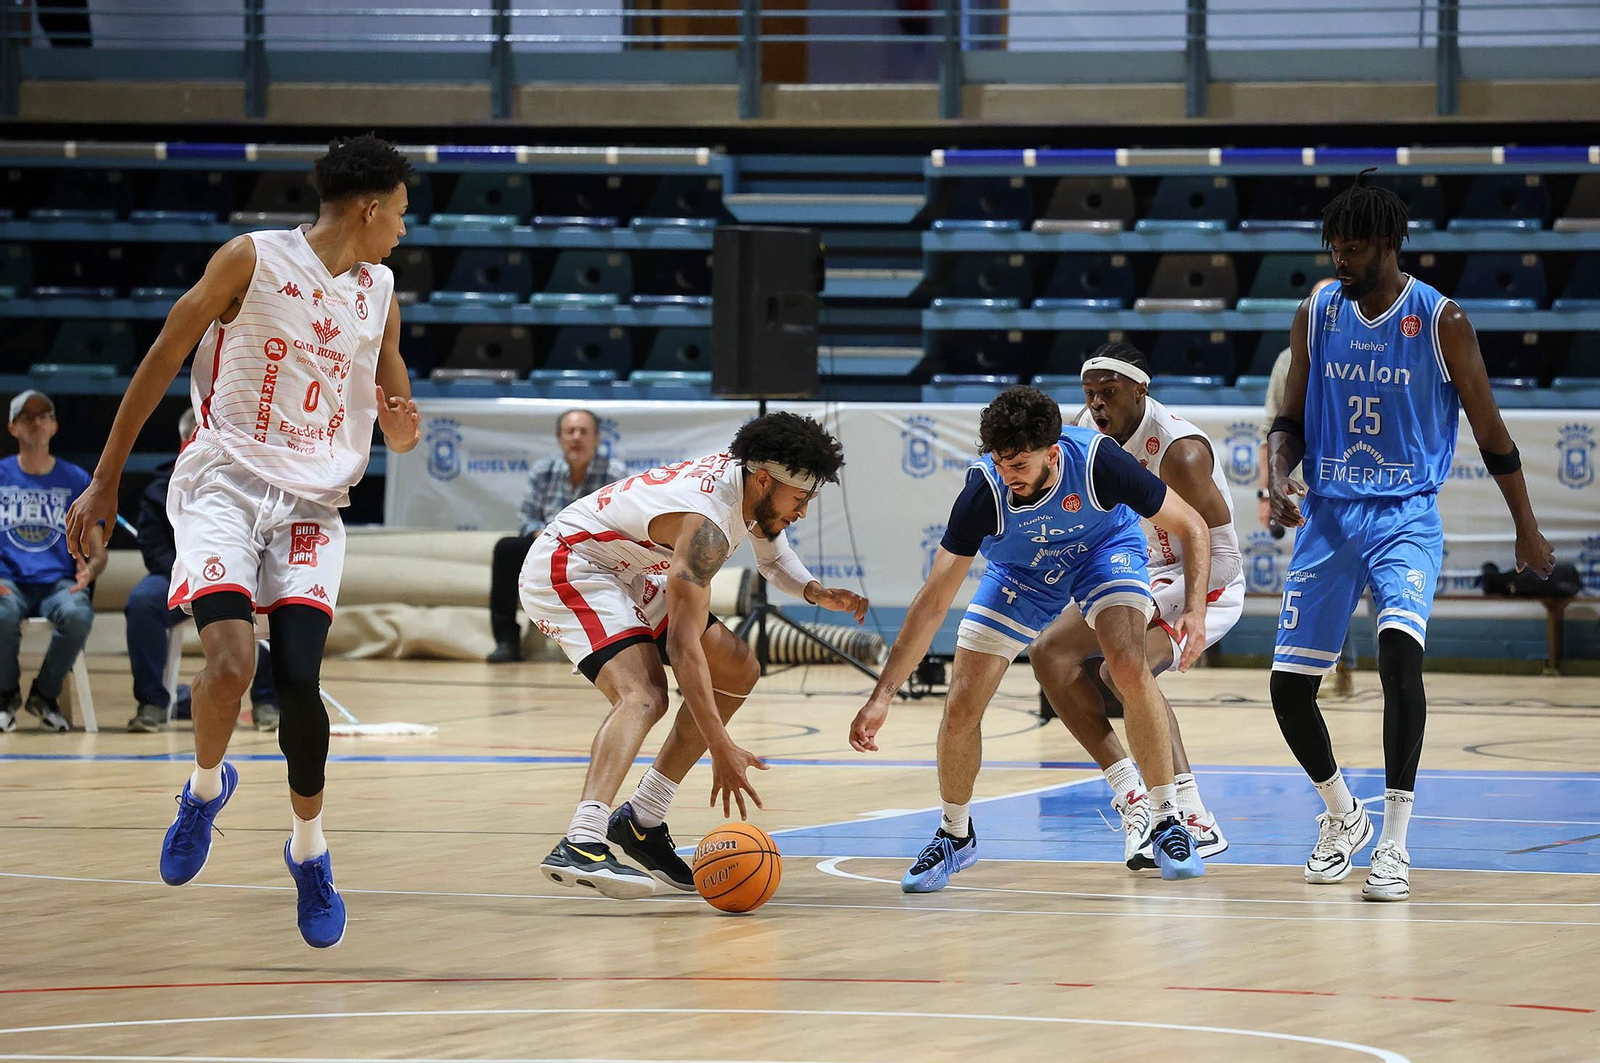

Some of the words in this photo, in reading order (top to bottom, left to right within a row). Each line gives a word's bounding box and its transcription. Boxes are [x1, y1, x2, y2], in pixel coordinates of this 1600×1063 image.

[316, 346, 346, 363] RURAL
[303, 380, 320, 413] 0
[1348, 396, 1381, 435] 25
[467, 459, 530, 473] HUELVA
[1319, 463, 1414, 485] EMERITA
